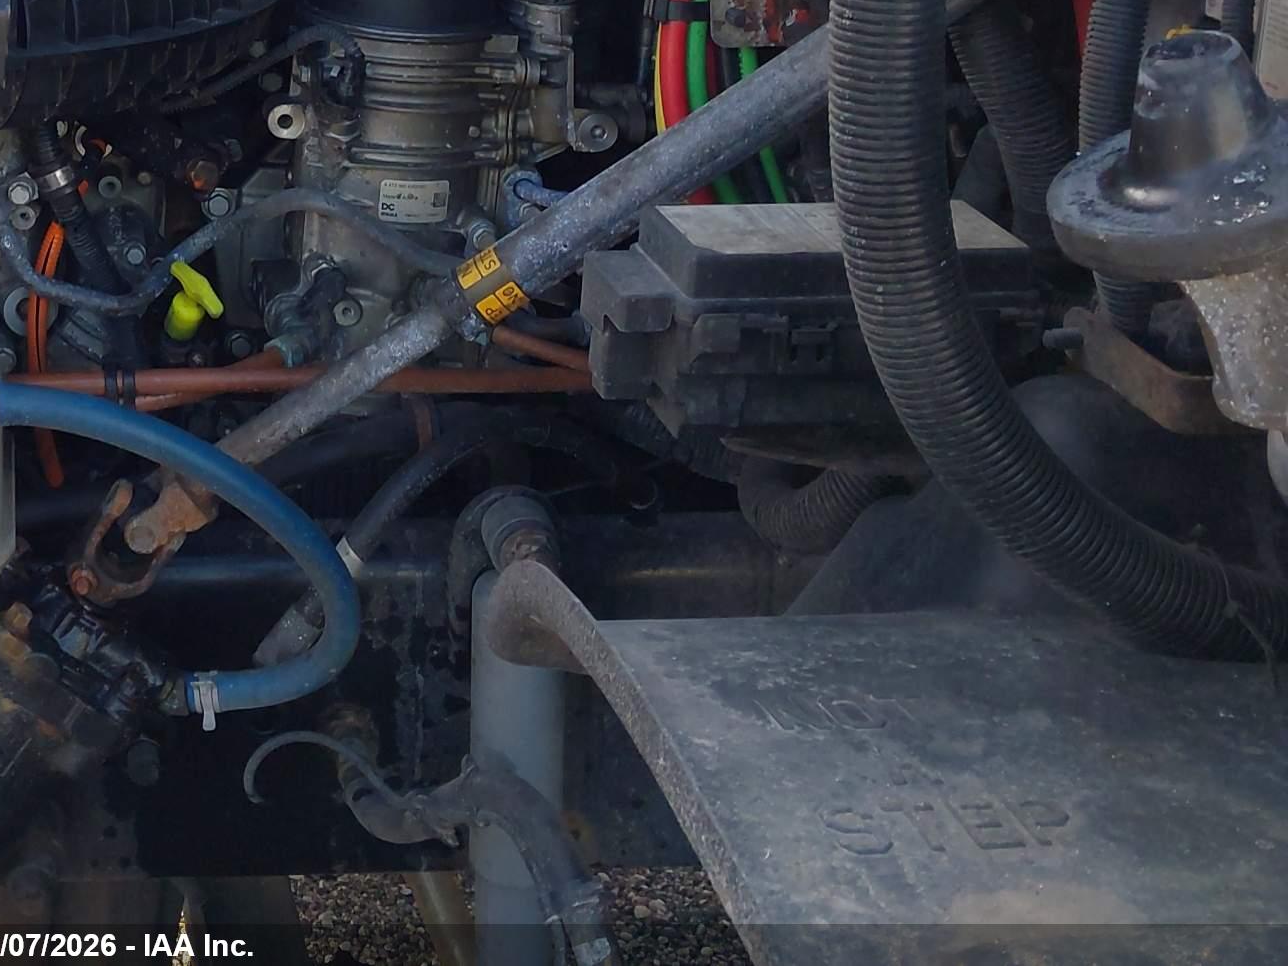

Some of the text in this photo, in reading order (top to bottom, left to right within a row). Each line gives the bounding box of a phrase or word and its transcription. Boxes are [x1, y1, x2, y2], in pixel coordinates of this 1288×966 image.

[382, 202, 395, 211] DC
[753, 694, 920, 733] NOT
[817, 800, 1071, 856] STEP
